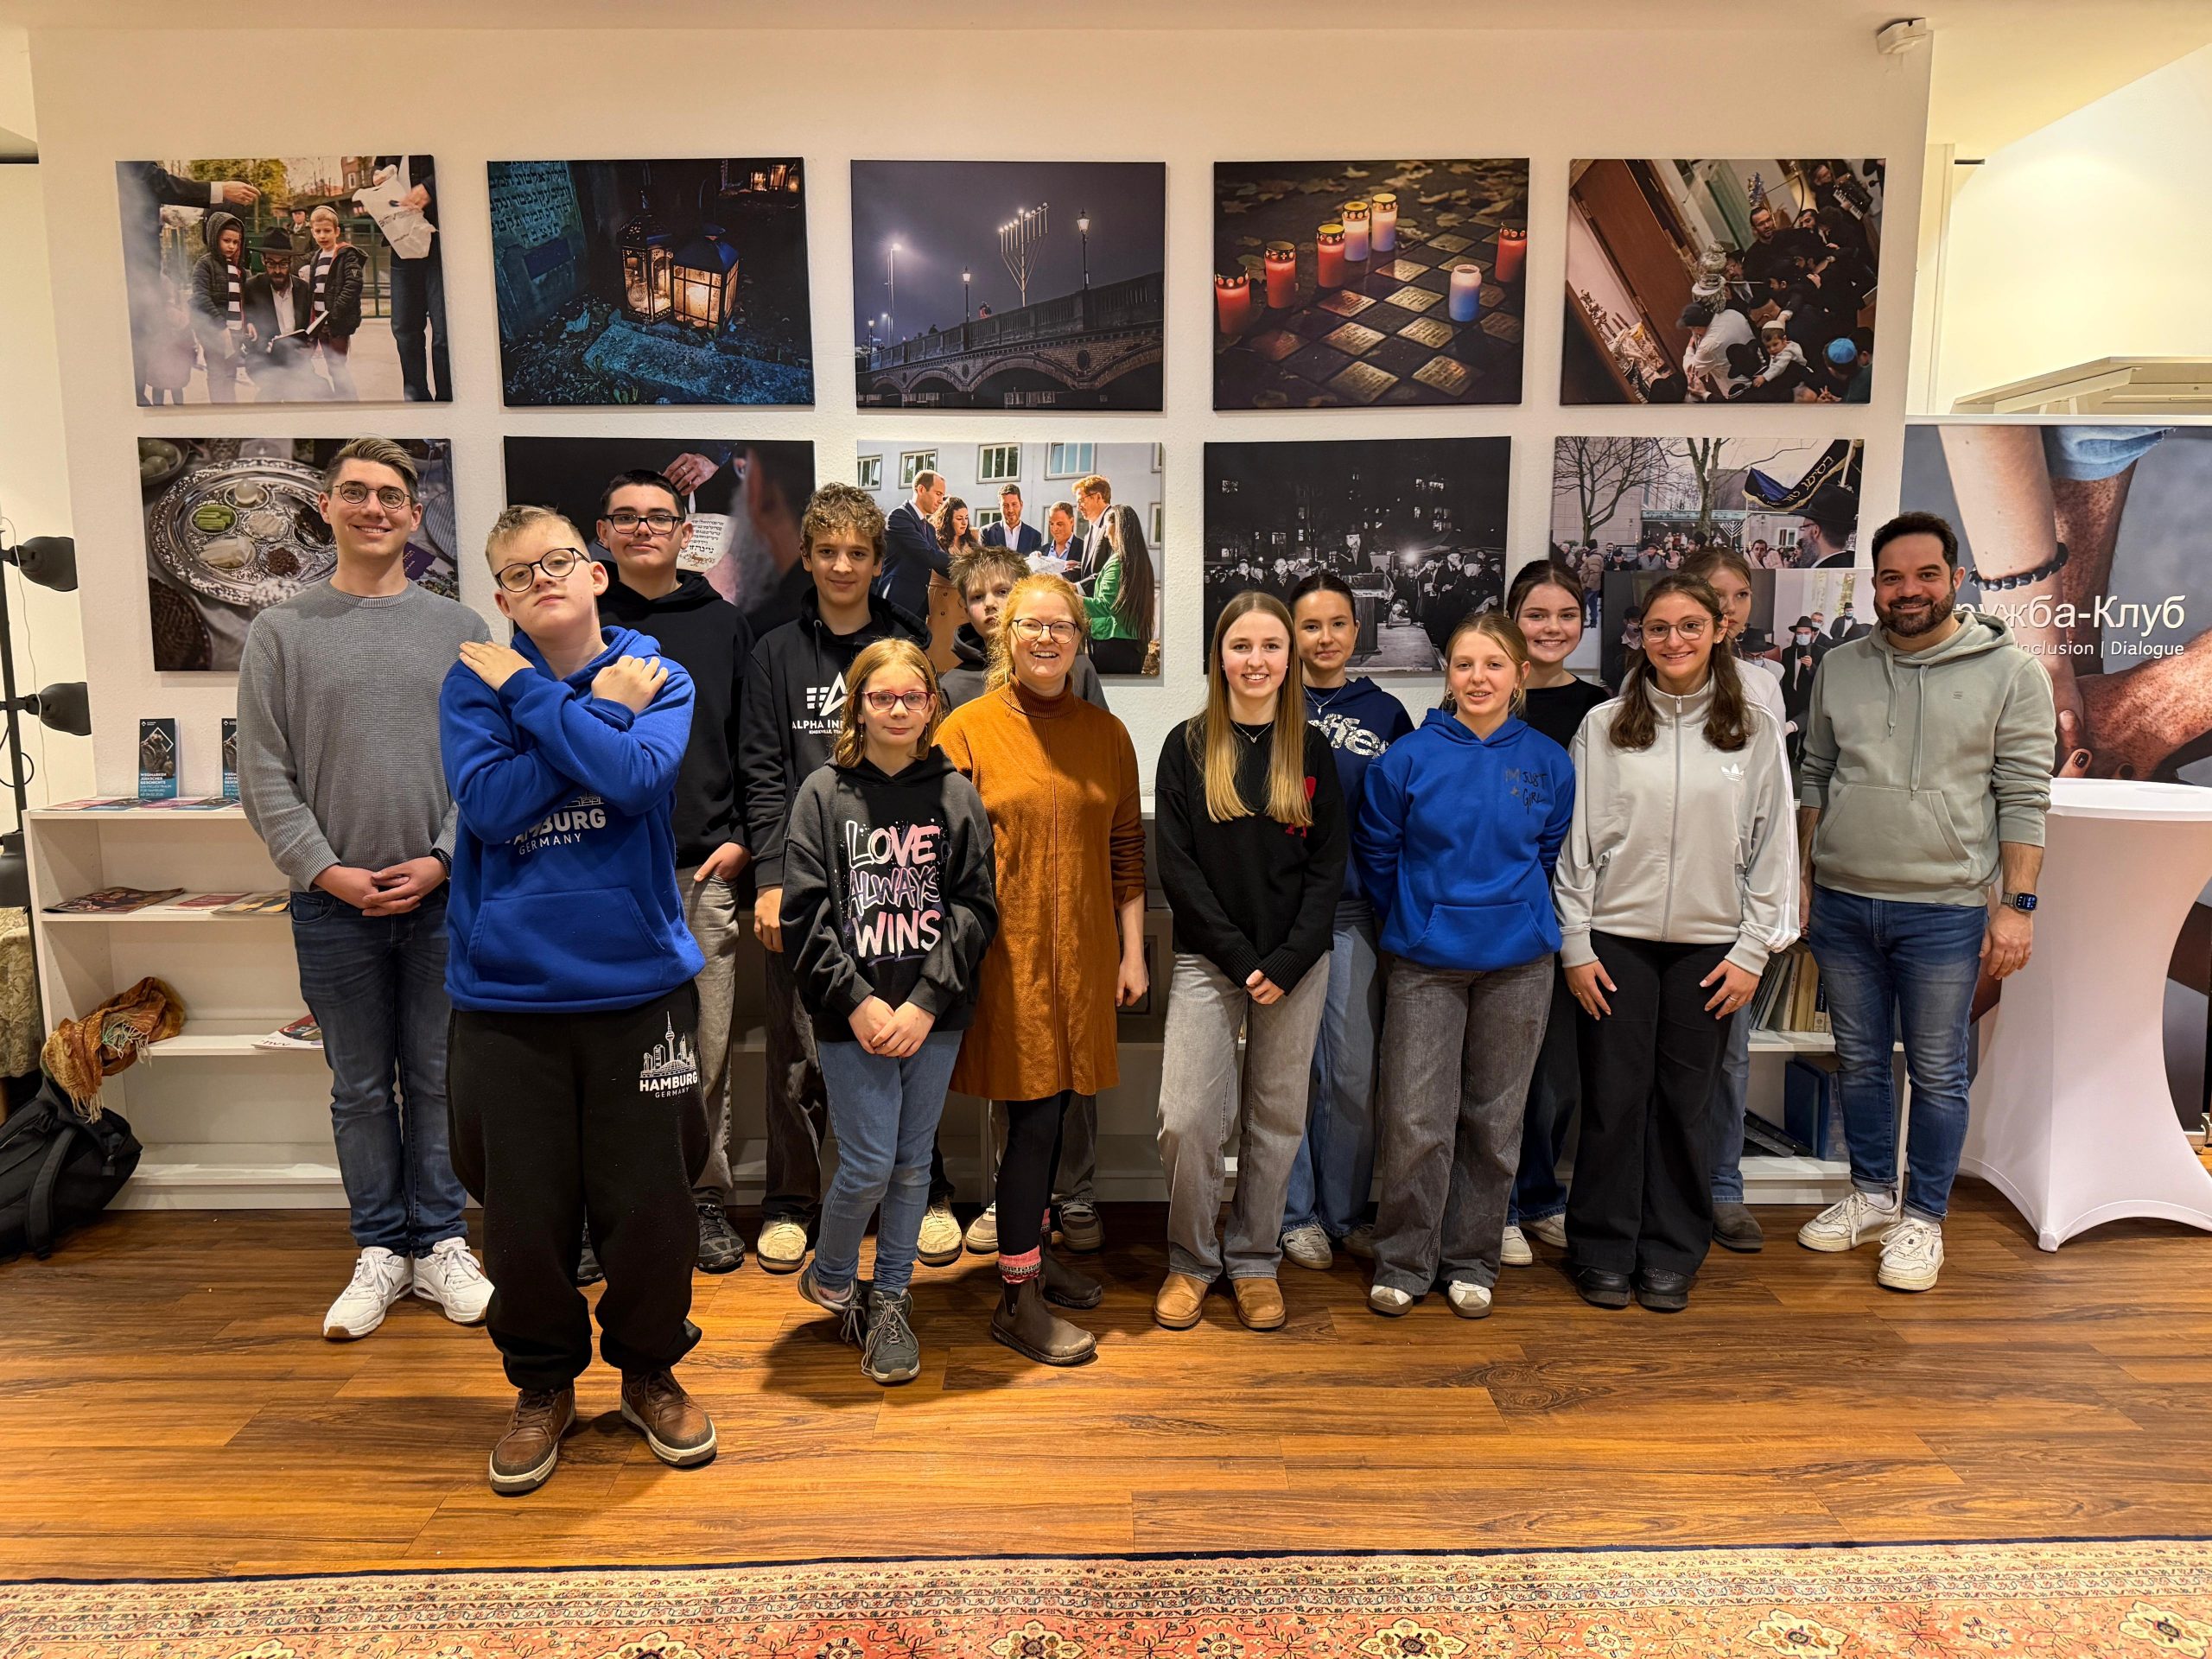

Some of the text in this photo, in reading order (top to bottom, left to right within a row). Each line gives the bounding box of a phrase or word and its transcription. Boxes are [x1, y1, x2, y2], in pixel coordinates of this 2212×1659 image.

[1955, 594, 2186, 638] жба-Клуб
[2111, 641, 2185, 659] Dialogue
[791, 720, 824, 729] ALPHA
[1307, 713, 1389, 760] ffe
[1522, 771, 1548, 790] JUST
[1522, 787, 1547, 816] GIRL
[505, 808, 607, 845] AMBURG
[518, 832, 582, 855] GERMANY
[845, 820, 941, 869] LOVE
[847, 865, 941, 918] ALWAYS
[851, 909, 942, 958] WINS
[639, 1071, 698, 1092] HAMBURG
[655, 1086, 690, 1098] GERMANY
